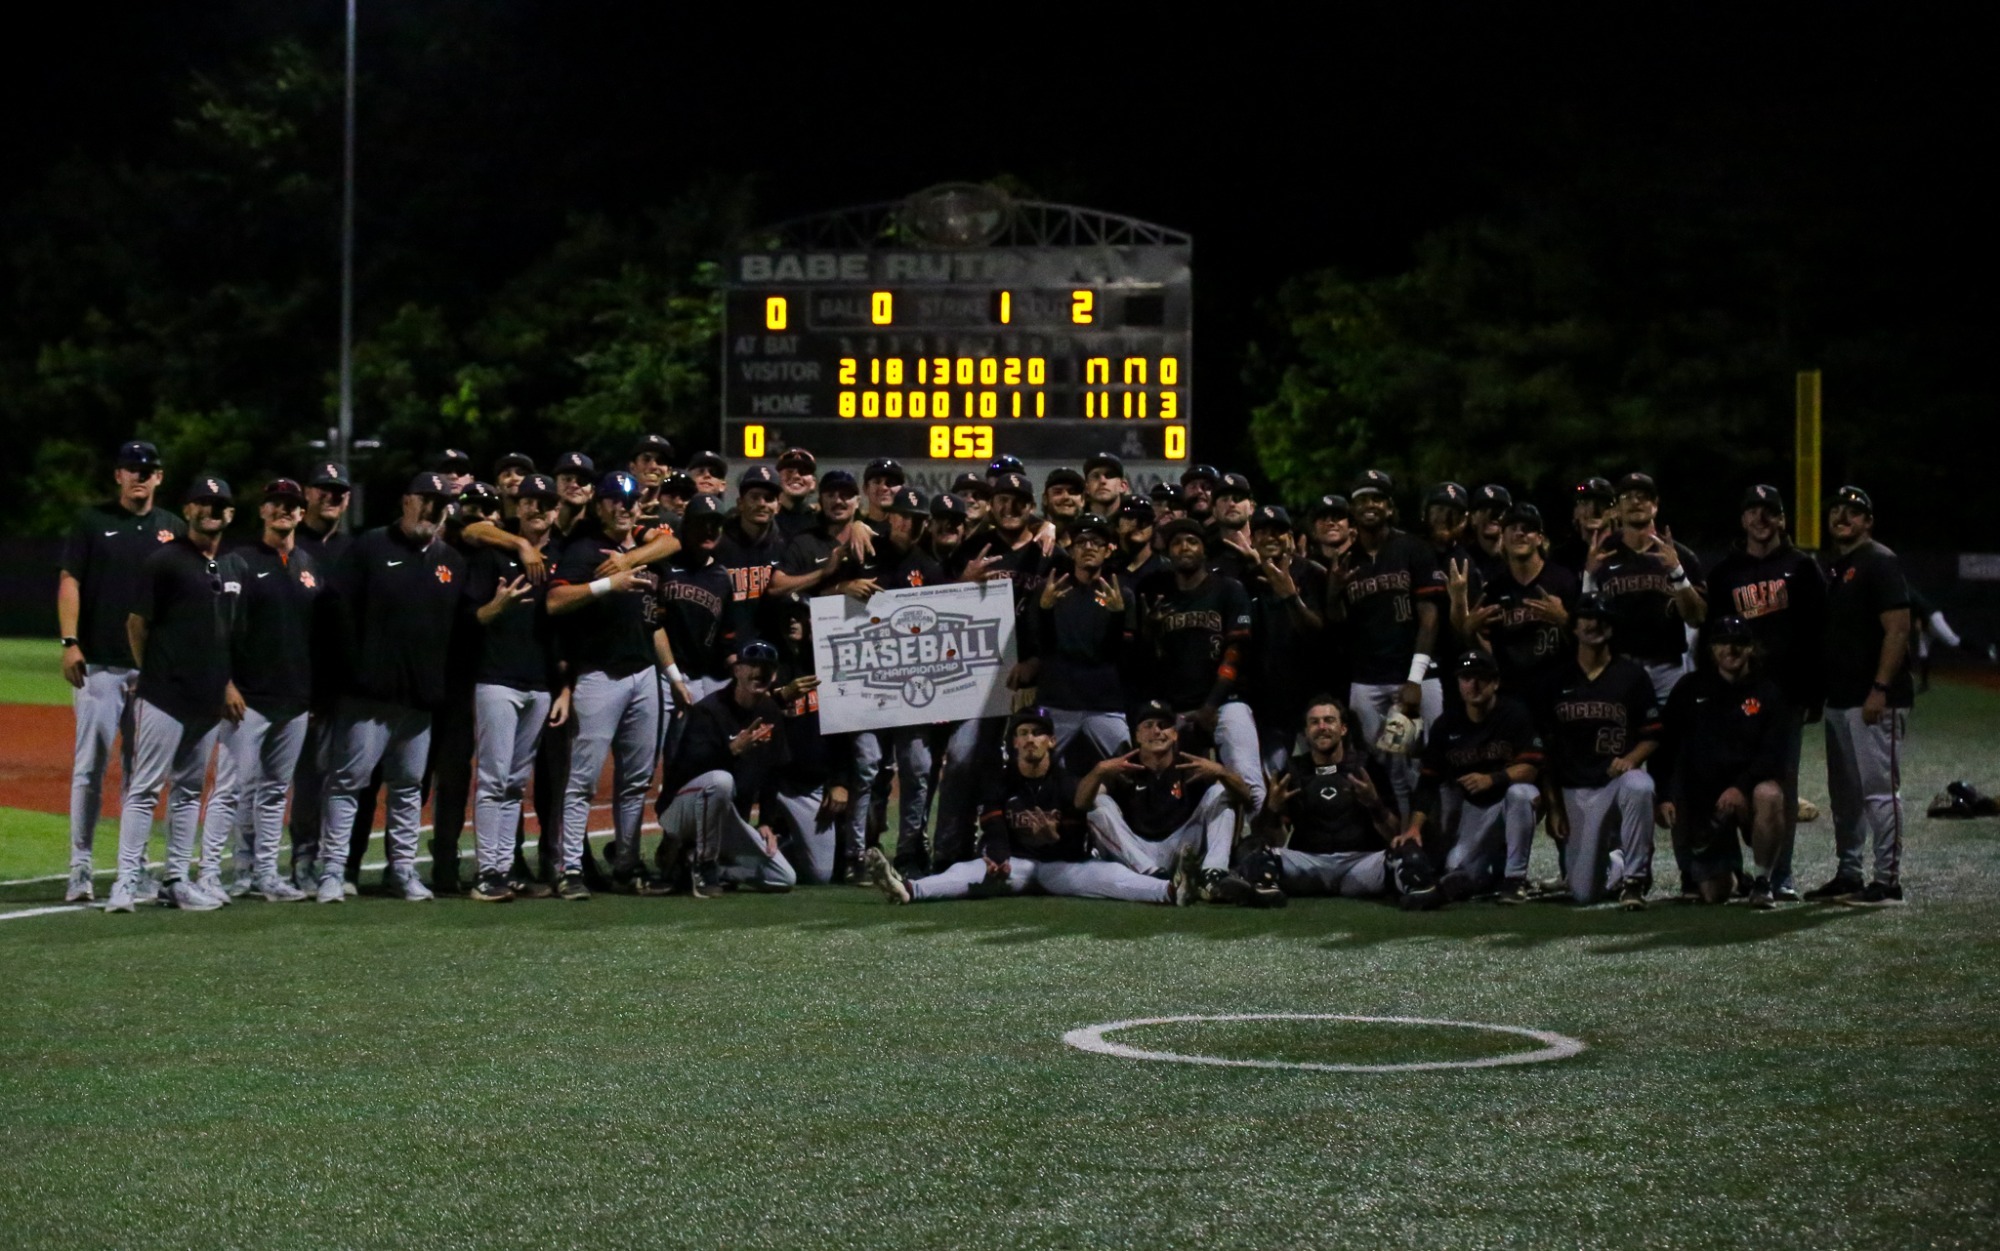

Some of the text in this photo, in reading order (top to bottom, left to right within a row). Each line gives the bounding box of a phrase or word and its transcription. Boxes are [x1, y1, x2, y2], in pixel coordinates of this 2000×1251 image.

[741, 254, 868, 281] BABE
[766, 297, 787, 330] 0
[871, 291, 893, 325] 0
[1000, 291, 1011, 324] 1
[1072, 290, 1093, 324] 2
[735, 336, 798, 355] AT BAT
[739, 361, 821, 381] VISITOR
[752, 394, 811, 414] HOME
[744, 425, 765, 458] 0
[1164, 425, 1186, 460] 0
[663, 580, 723, 619] TIGERS
[1347, 569, 1412, 606] TIGERS
[880, 628, 891, 638] 20
[837, 629, 995, 672] BASEBALL
[1554, 701, 1628, 727] TIGERS
[1595, 726, 1627, 756] 25
